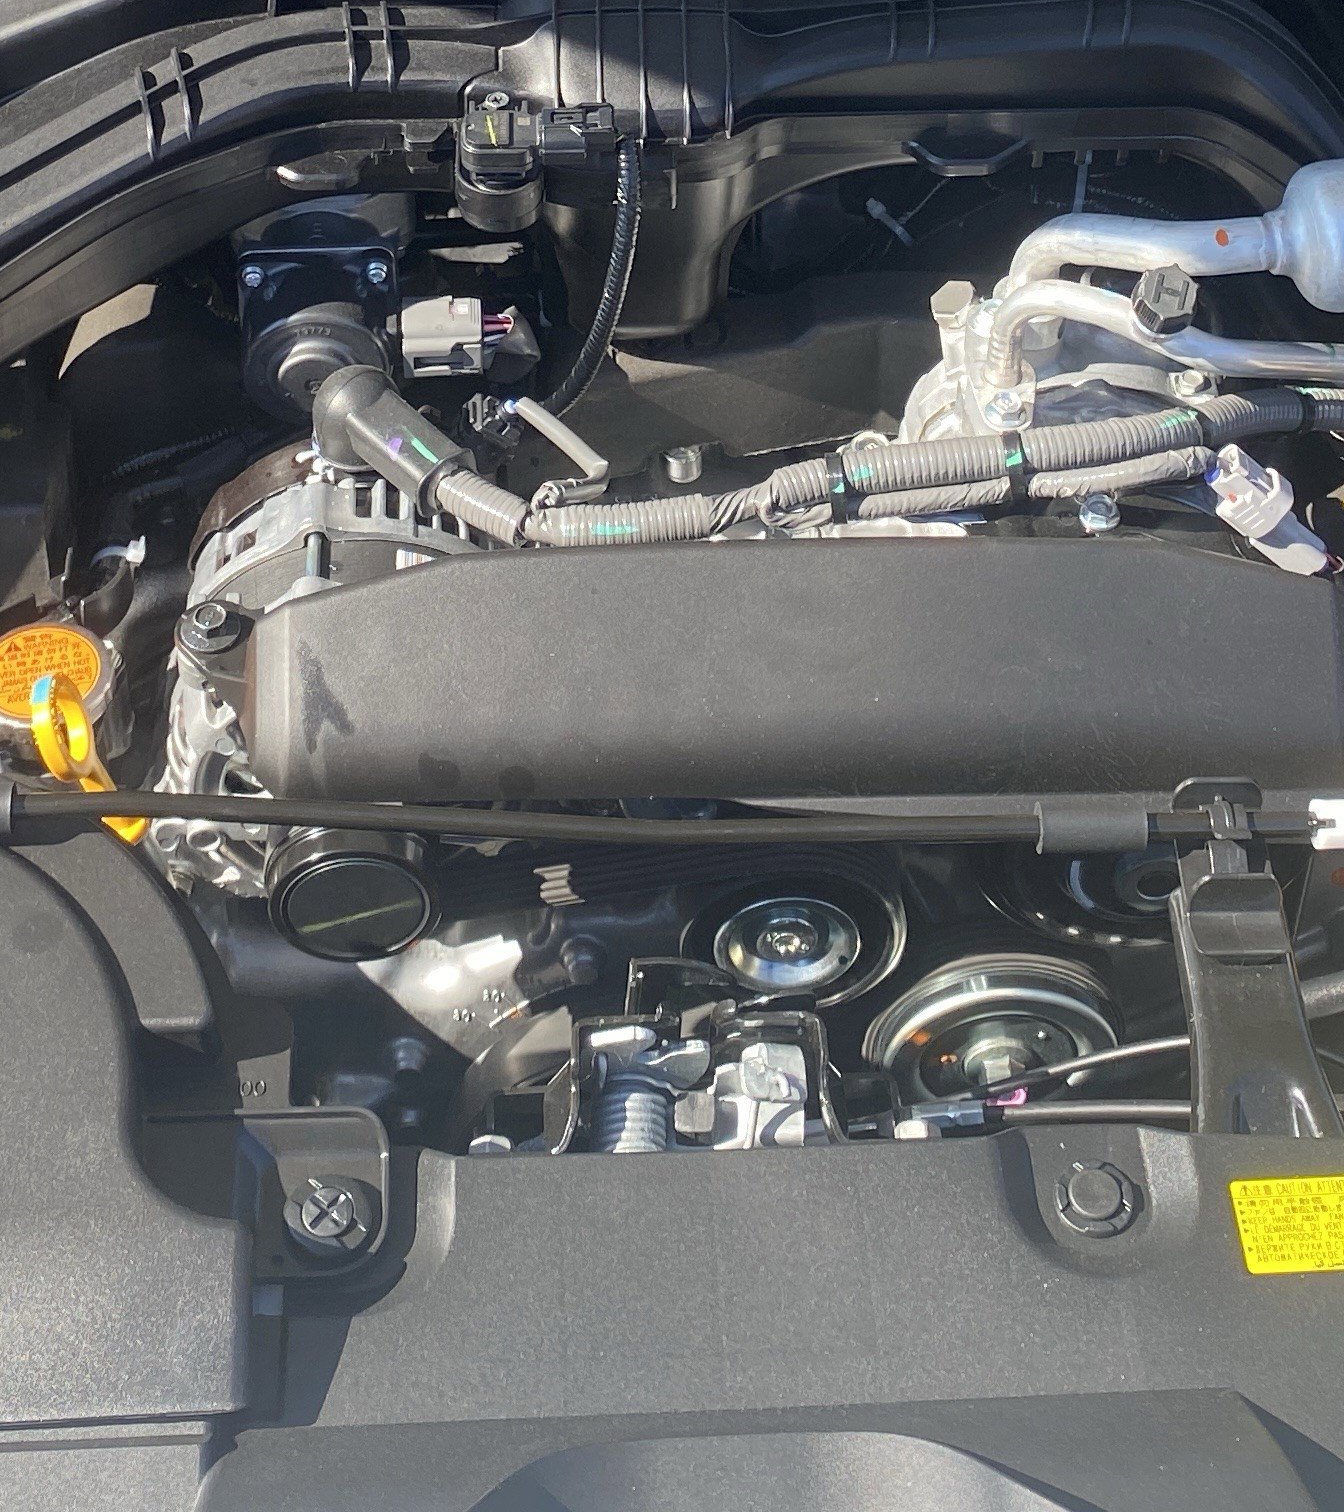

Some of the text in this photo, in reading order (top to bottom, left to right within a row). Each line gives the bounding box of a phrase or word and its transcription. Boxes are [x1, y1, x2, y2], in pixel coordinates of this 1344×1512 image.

[23, 637, 68, 650] WARNING
[19, 665, 42, 675] OPEN
[44, 661, 71, 671] WHEN
[1276, 1182, 1312, 1194] CAUTION
[1248, 1216, 1268, 1225] KEEP
[1272, 1215, 1297, 1223] HANDS
[1329, 1212, 1344, 1220] FAN
[1310, 1222, 1321, 1231] DU
[1278, 1232, 1323, 1242] APPROCHEZ
[1328, 1231, 1344, 1240] PAS
